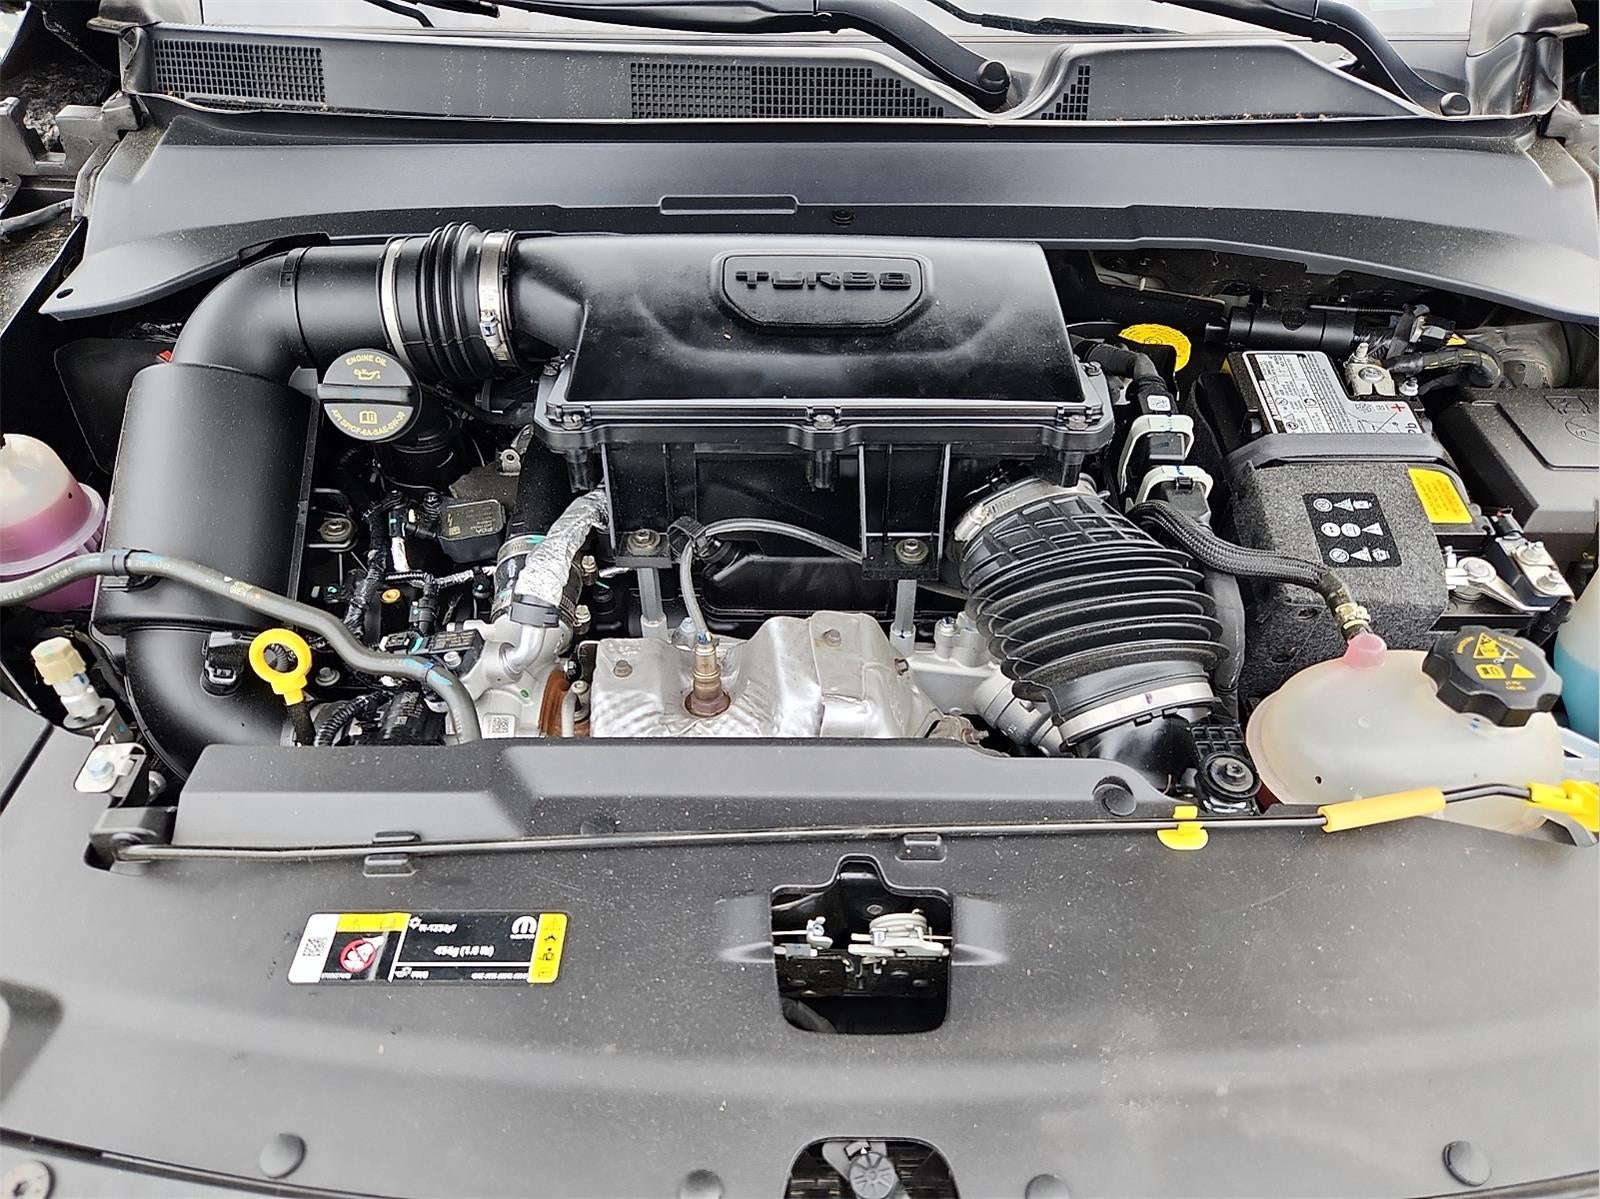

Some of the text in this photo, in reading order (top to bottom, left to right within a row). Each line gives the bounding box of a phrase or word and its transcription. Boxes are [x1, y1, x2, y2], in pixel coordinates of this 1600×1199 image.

[735, 270, 913, 290] TURBO
[345, 354, 387, 367] ENGINE OIL
